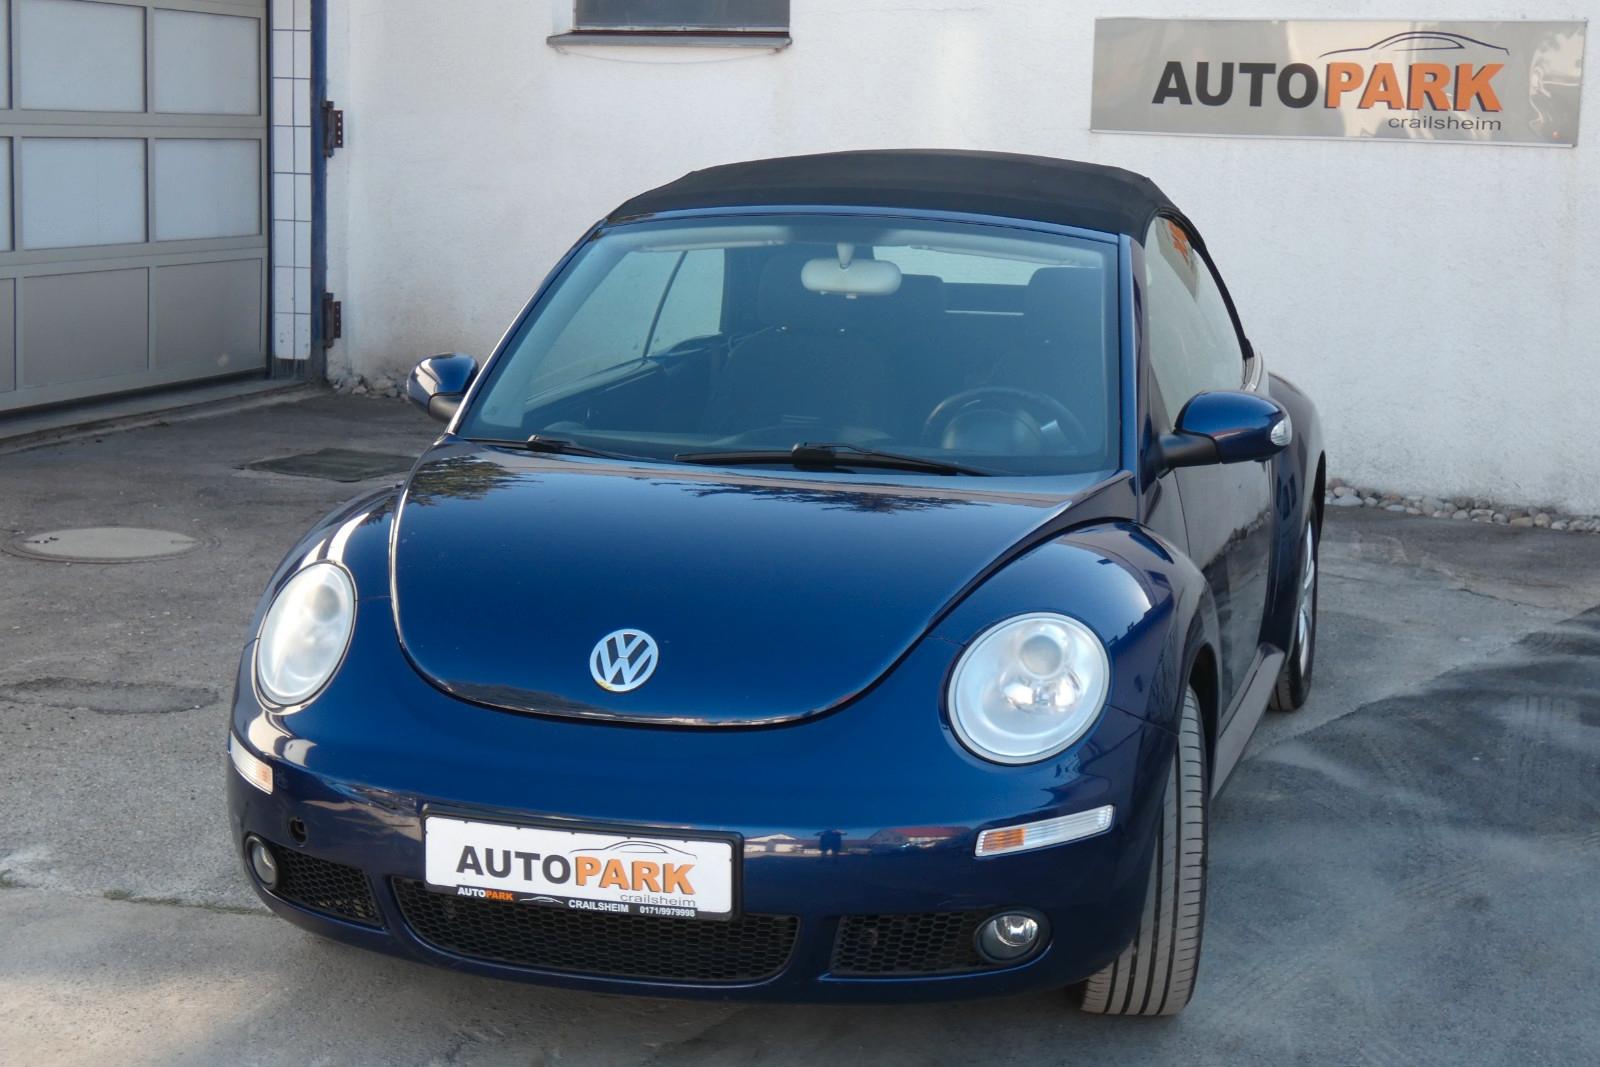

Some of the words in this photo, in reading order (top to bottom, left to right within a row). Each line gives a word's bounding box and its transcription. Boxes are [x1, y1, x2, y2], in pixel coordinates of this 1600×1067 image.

[1151, 61, 1504, 112] AUTOPARK
[1388, 115, 1502, 131] crailsheim
[590, 628, 659, 692] VW
[457, 845, 695, 895] AUTOPARK
[457, 887, 513, 901] AUTOPARK
[568, 899, 629, 913] CRAILSHEIM
[620, 893, 696, 907] crailsheim
